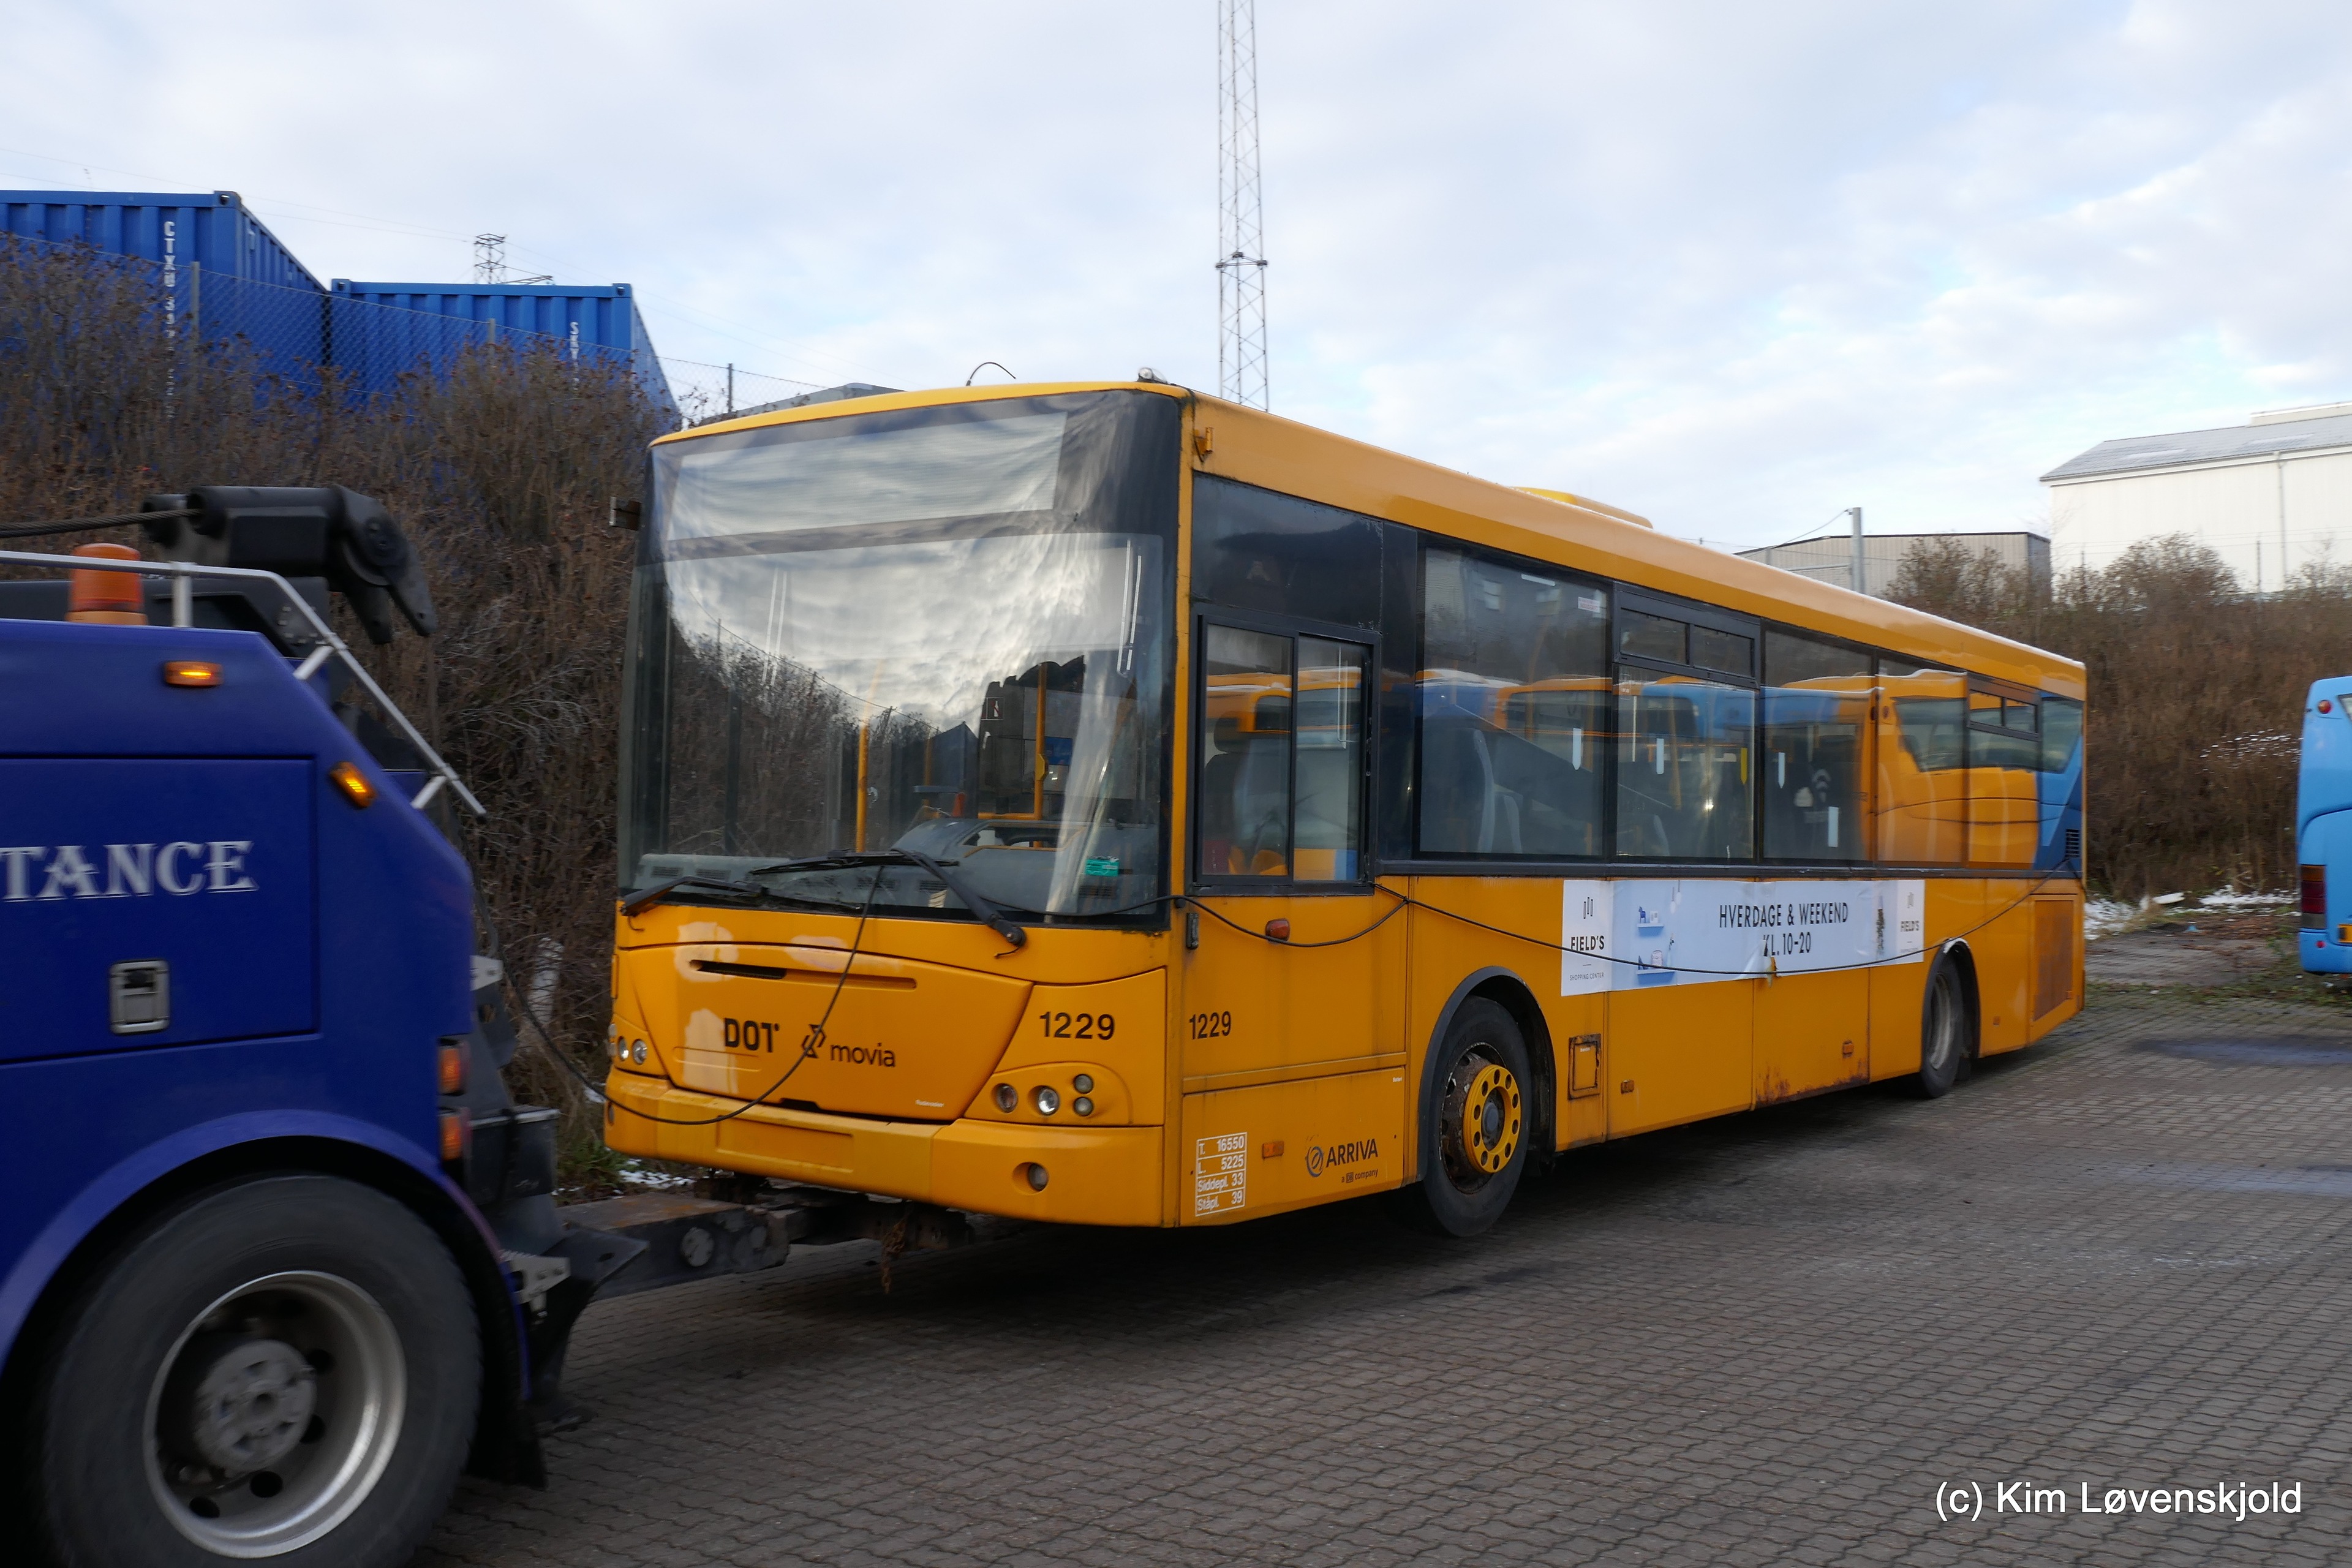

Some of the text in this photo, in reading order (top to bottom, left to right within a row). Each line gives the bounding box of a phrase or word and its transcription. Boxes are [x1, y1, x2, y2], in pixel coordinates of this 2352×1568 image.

[1719, 902, 1849, 928] HVERDAGE & WEEKEND
[1571, 935, 1605, 951] FIELD'S
[1782, 932, 1811, 956] 10-20
[1039, 1011, 1115, 1041] 1229
[1189, 1011, 1232, 1040] 1229
[830, 1042, 895, 1068] movia
[1217, 1136, 1245, 1152] 16550
[1326, 1139, 1378, 1167] ARRIVA
[1221, 1155, 1244, 1170] 5225
[1231, 1172, 1243, 1187] 33
[1355, 1169, 1378, 1180] company
[1231, 1191, 1243, 1205] 39
